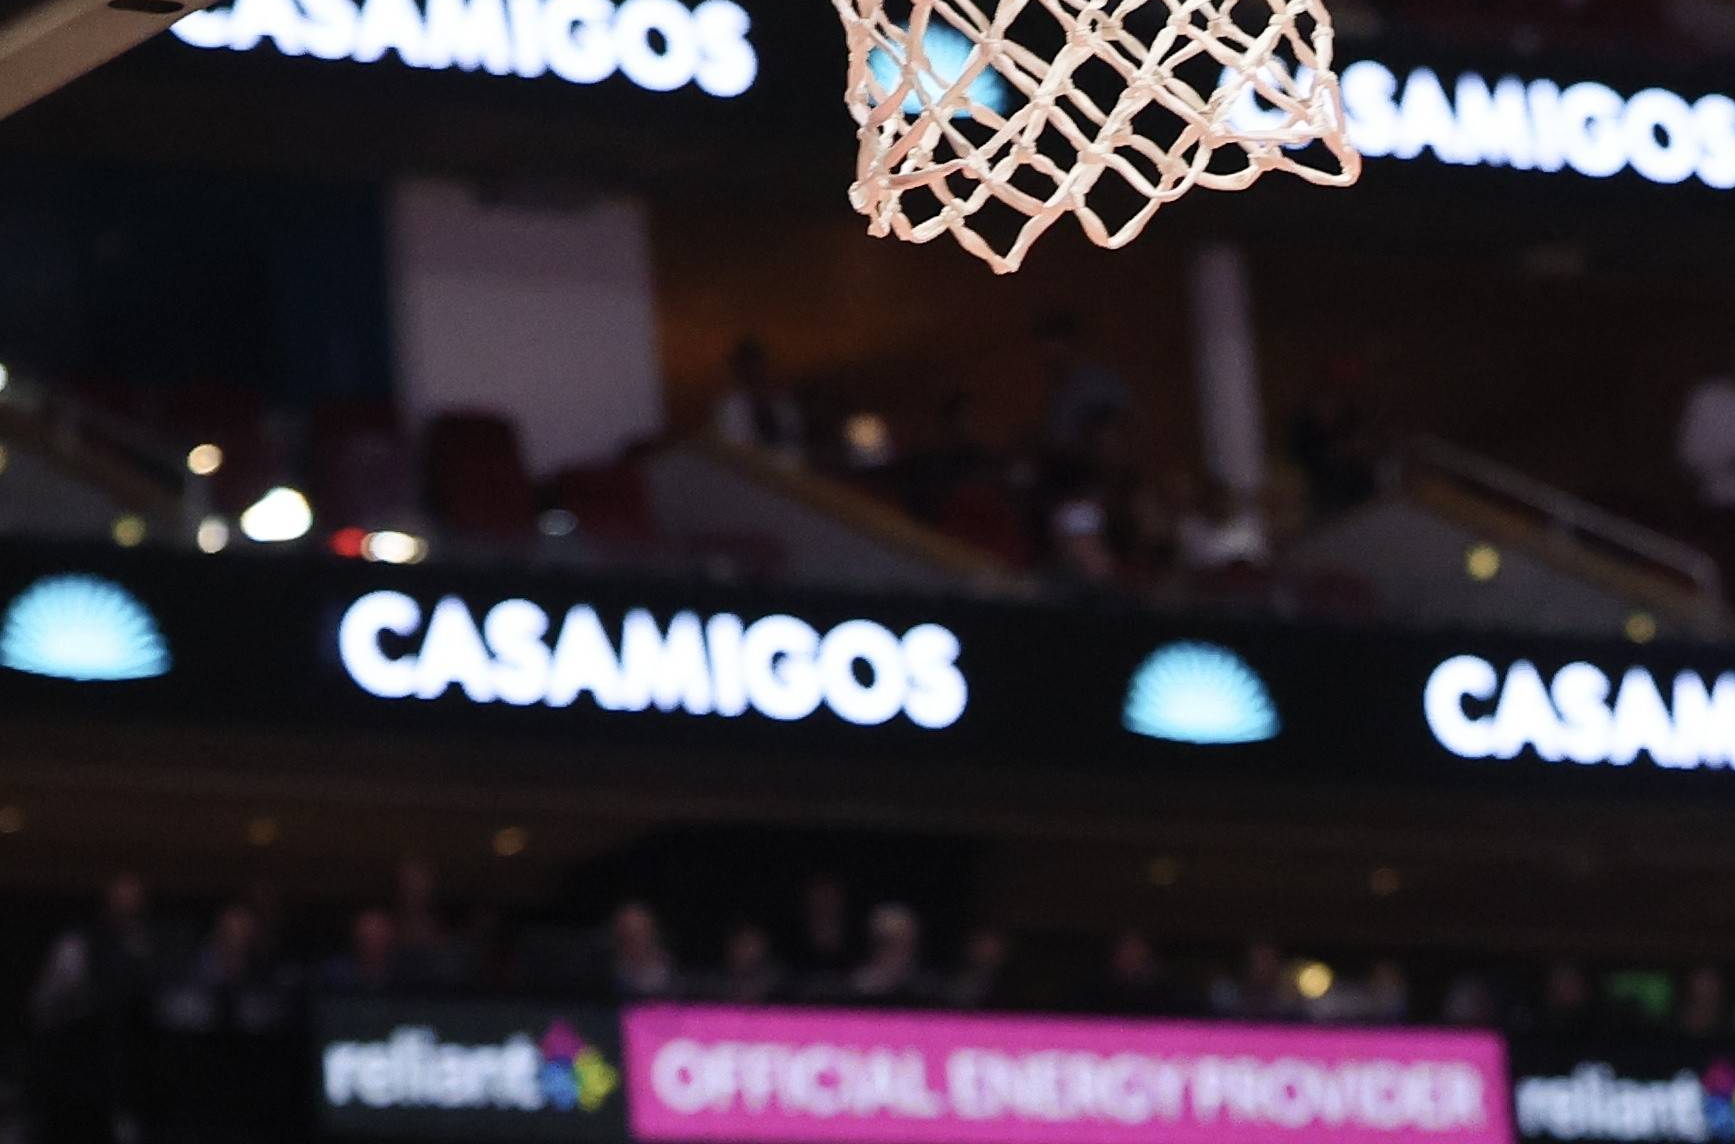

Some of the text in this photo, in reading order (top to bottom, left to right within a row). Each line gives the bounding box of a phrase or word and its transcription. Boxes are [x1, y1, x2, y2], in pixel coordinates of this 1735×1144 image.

[338, 590, 968, 729] CASAMIGOS
[324, 1026, 542, 1110] reliant
[651, 1038, 1485, 1132] OFFICIAL ENERGY PROVIDER
